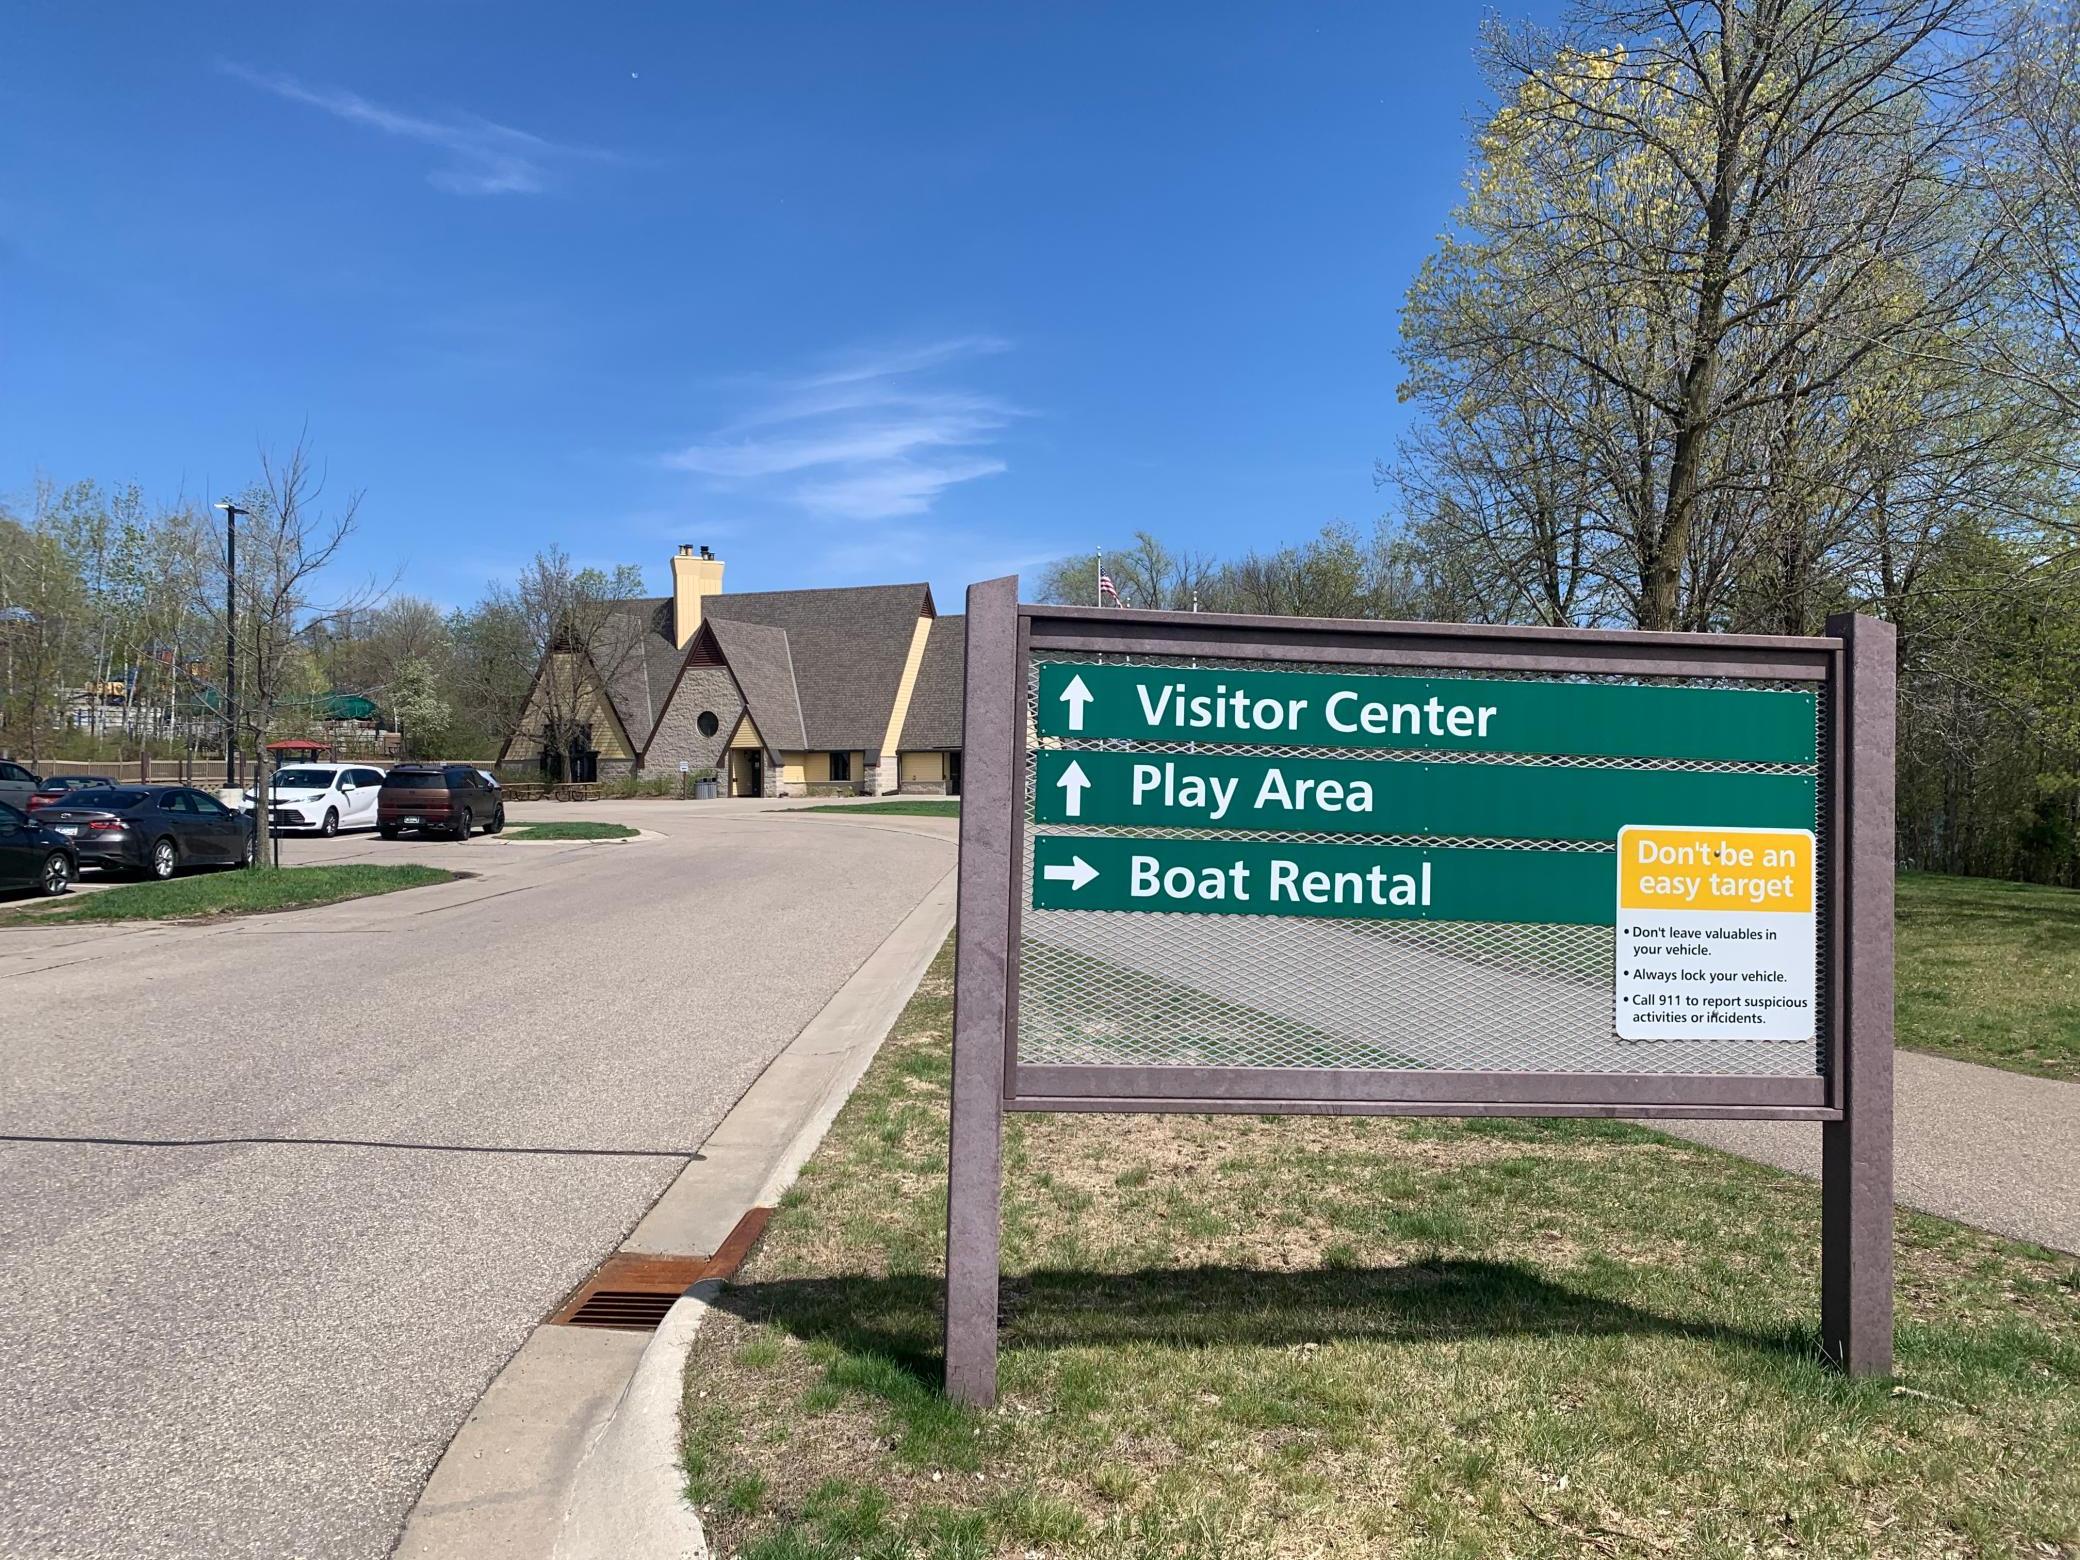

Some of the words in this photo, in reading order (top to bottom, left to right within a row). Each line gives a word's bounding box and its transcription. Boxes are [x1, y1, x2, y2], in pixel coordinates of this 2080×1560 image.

[1136, 684, 1307, 731] Visitor
[1325, 691, 1497, 737] Center
[1132, 763, 1240, 820] Play
[1254, 768, 1374, 812] Area
[1638, 840, 1711, 865] Don't
[1720, 841, 1754, 866] be
[1762, 849, 1796, 867] an
[1130, 855, 1250, 900] Boat
[1269, 860, 1432, 906] Rental
[1639, 875, 1701, 901] easy
[1709, 873, 1794, 903] target
[1633, 927, 1666, 938] Don't
[1669, 928, 1702, 939] leave
[1705, 928, 1763, 940] valuables
[1766, 930, 1777, 940] in
[1633, 945, 1662, 957] your
[1666, 944, 1711, 956] vehicle.
[1633, 969, 1677, 981] Always
[1681, 970, 1706, 981] lock
[1710, 972, 1738, 983] your
[1741, 971, 1787, 982] vehicle.
[1632, 994, 1655, 1005] Call
[1659, 995, 1681, 1006] 911
[1686, 997, 1699, 1006] to
[1703, 997, 1742, 1010] report
[1744, 997, 1808, 1010] suspicious
[1632, 1012, 1687, 1023] activities
[1690, 1014, 1704, 1023] or
[1707, 1012, 1766, 1024] incidents.
